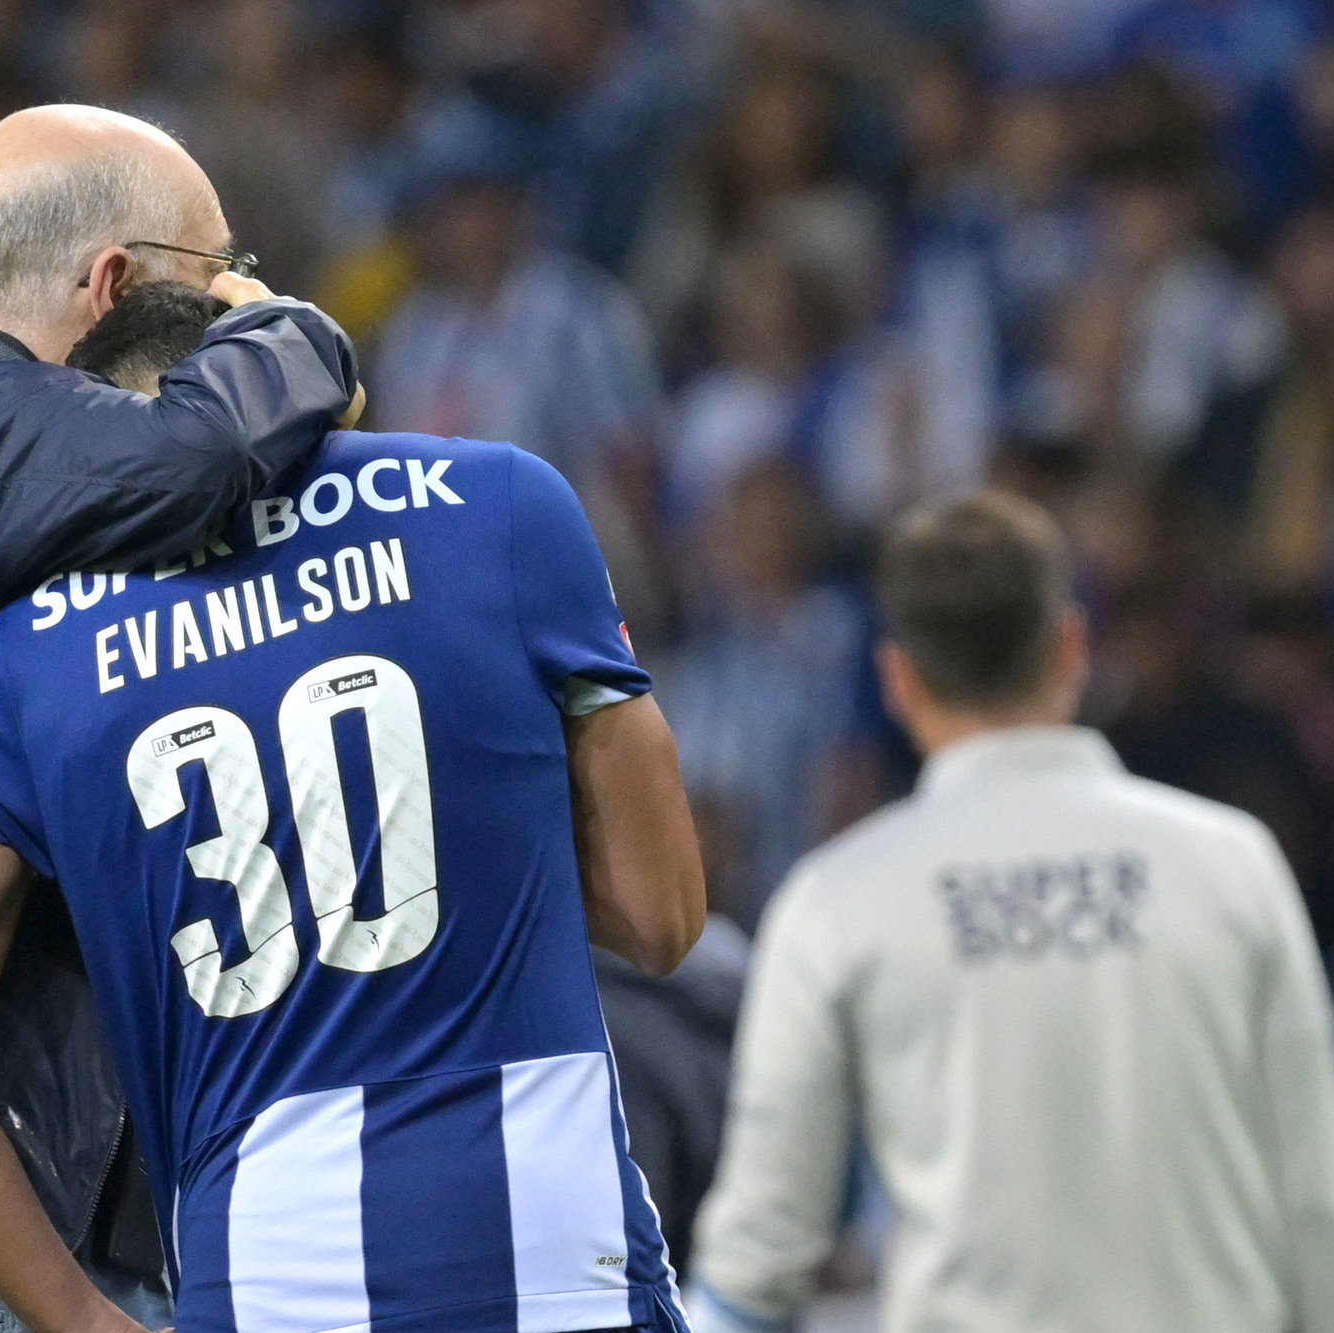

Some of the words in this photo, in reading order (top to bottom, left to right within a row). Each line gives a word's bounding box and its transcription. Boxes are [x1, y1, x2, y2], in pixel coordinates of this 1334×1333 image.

[251, 457, 466, 547] BOCK
[95, 537, 412, 695] EVANILSON
[337, 674, 374, 692] Betclic
[179, 726, 213, 745] Betclic
[126, 653, 439, 1019] 30
